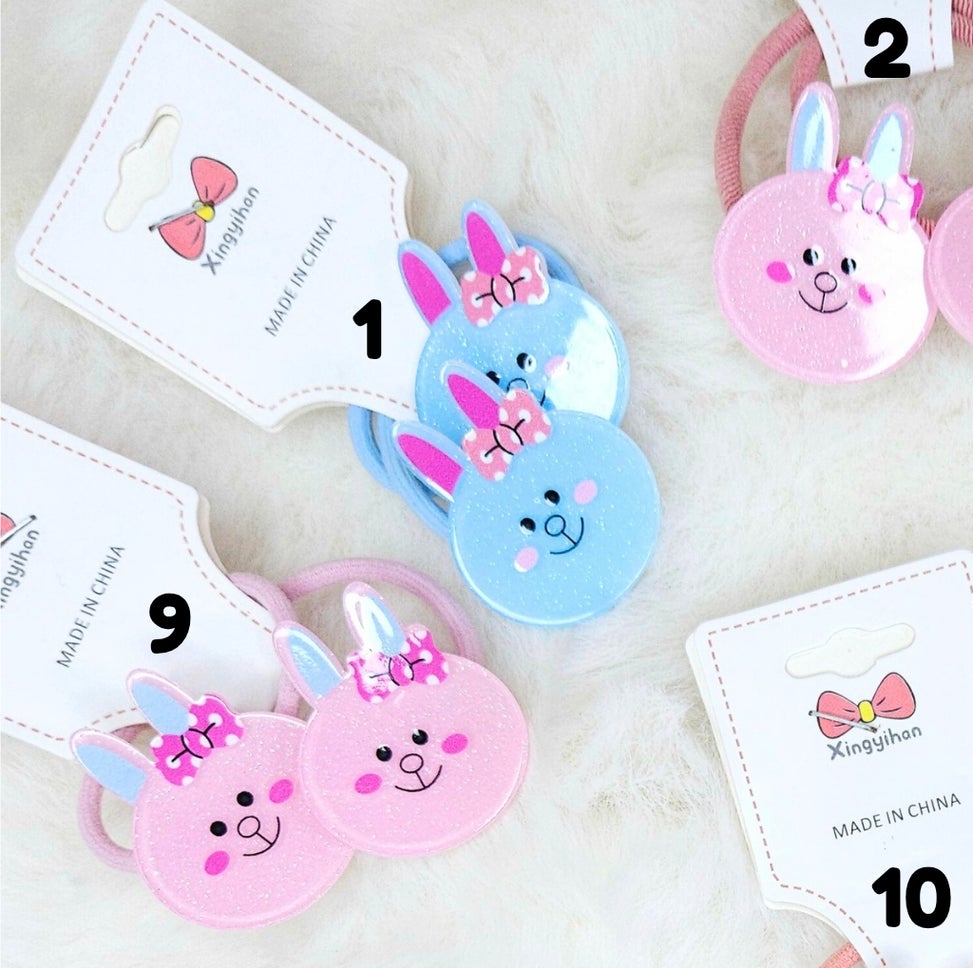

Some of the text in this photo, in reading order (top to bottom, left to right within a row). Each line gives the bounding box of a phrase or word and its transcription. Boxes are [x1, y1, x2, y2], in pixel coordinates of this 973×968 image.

[201, 186, 260, 275] Xingyihan
[265, 217, 336, 336] MADE IN CHINA
[56, 547, 125, 668] MADE IN CHINA
[826, 726, 923, 761] Xingyihan
[833, 793, 961, 839] MADE IN CHINA
